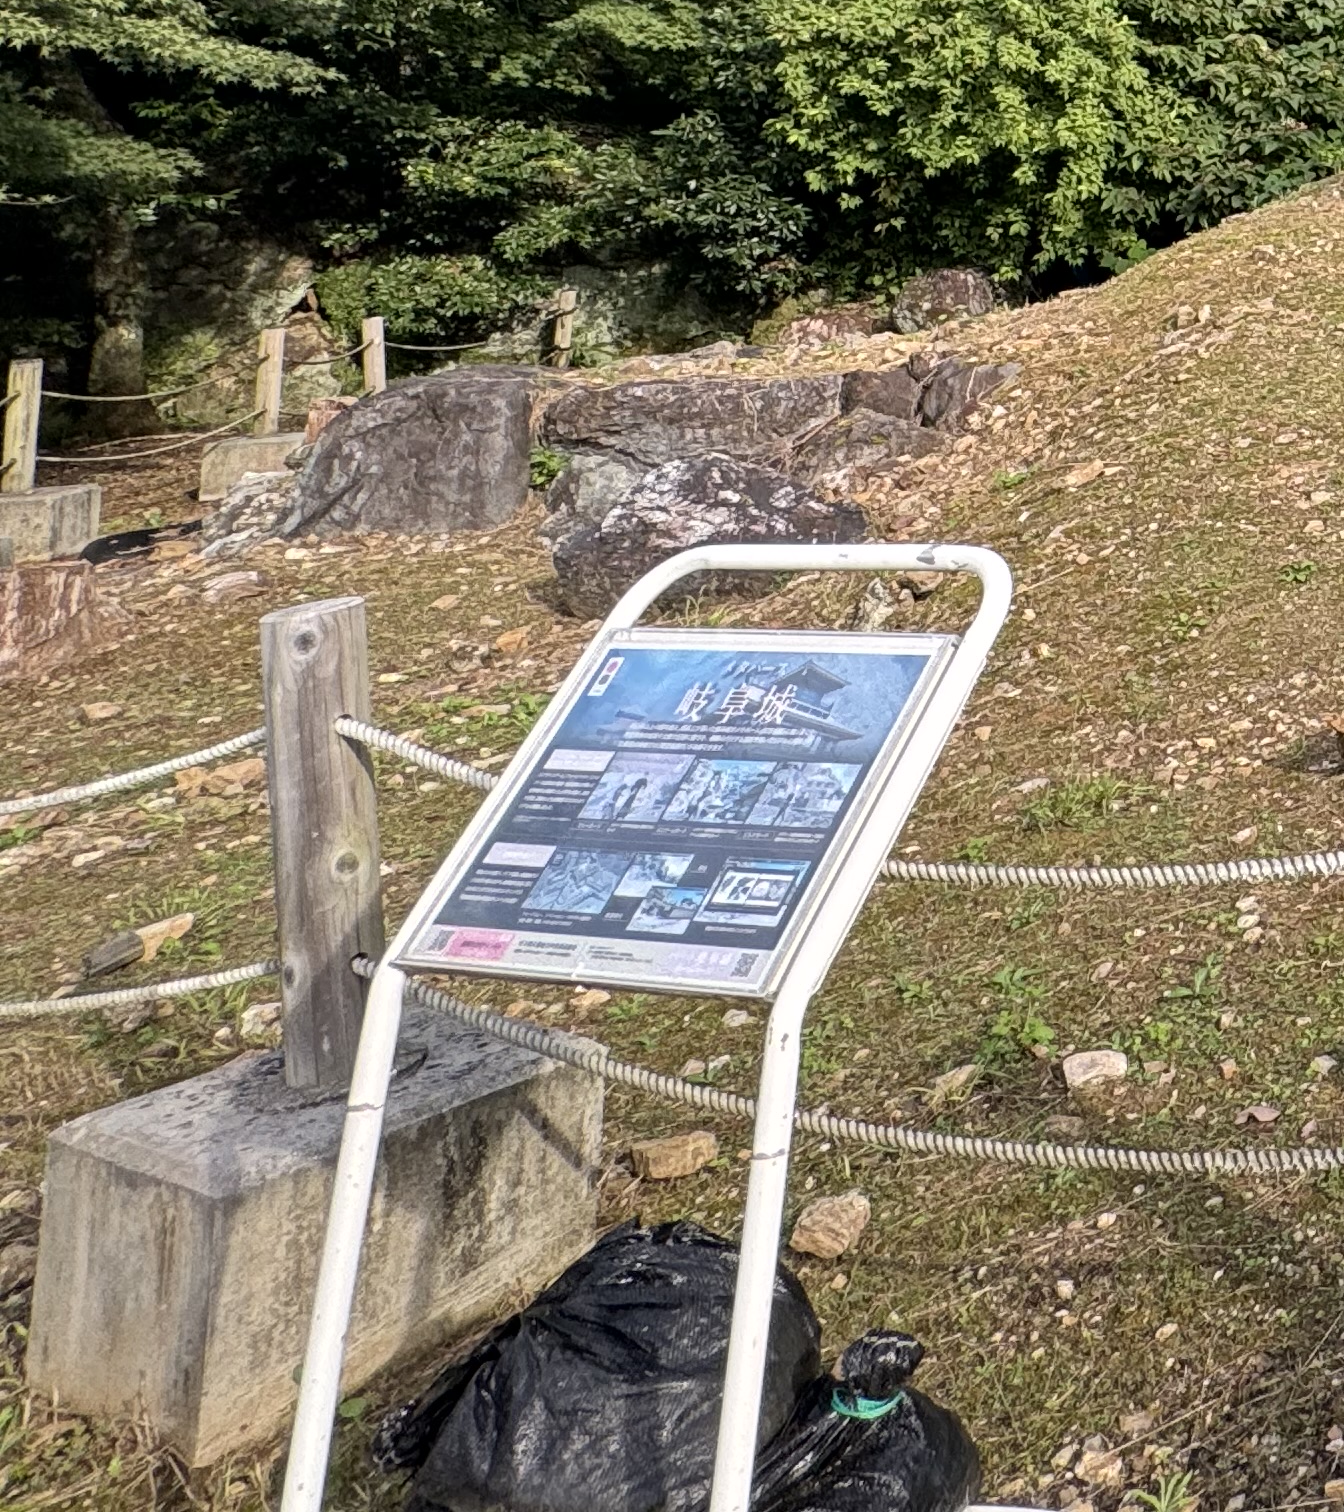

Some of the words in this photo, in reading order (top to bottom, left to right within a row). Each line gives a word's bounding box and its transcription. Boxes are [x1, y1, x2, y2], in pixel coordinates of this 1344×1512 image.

[720, 660, 789, 678] メタバース
[674, 682, 798, 724] 岐阜城
